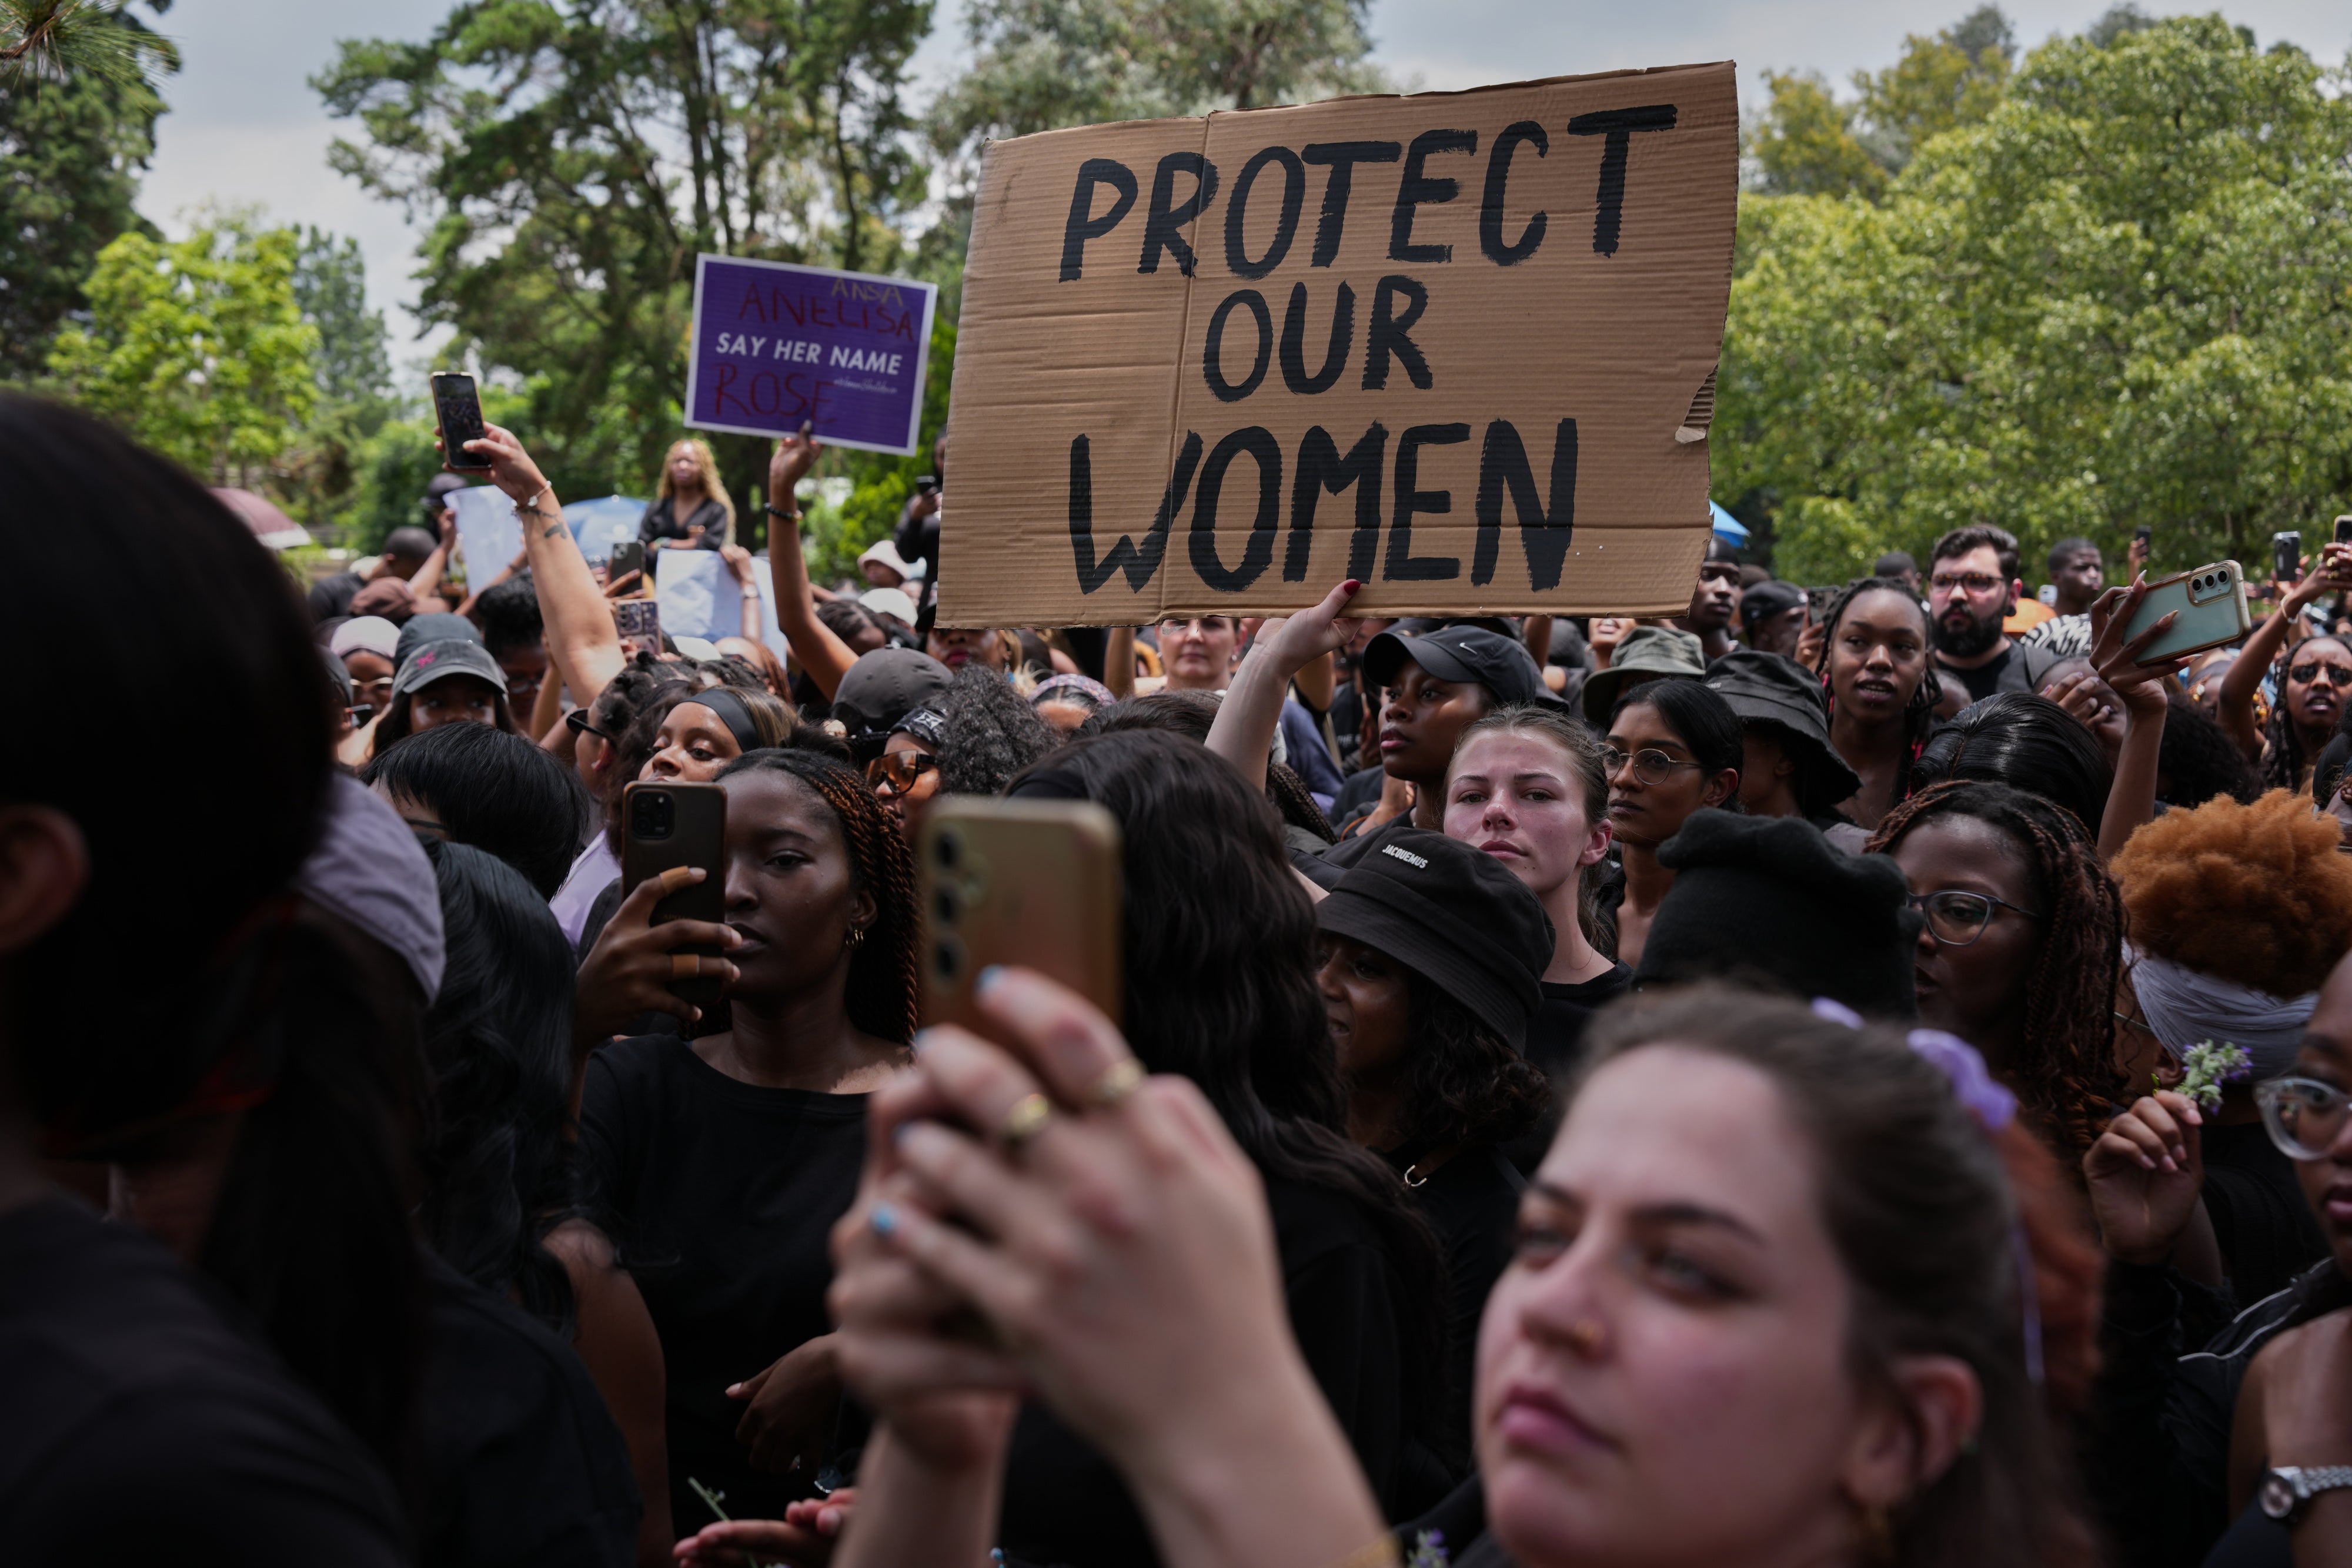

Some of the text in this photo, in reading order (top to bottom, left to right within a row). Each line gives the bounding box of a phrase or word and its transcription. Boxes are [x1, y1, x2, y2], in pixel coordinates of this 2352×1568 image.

[1058, 105, 1678, 282] PROTECT
[739, 282, 914, 342] ANELISA
[1203, 275, 1434, 402] OUR
[716, 333, 903, 375] SAY HER NAME
[713, 363, 837, 424] ROSE
[1070, 417, 1578, 594] WOMEN
[1382, 844, 1428, 868] JACQUEMUS
